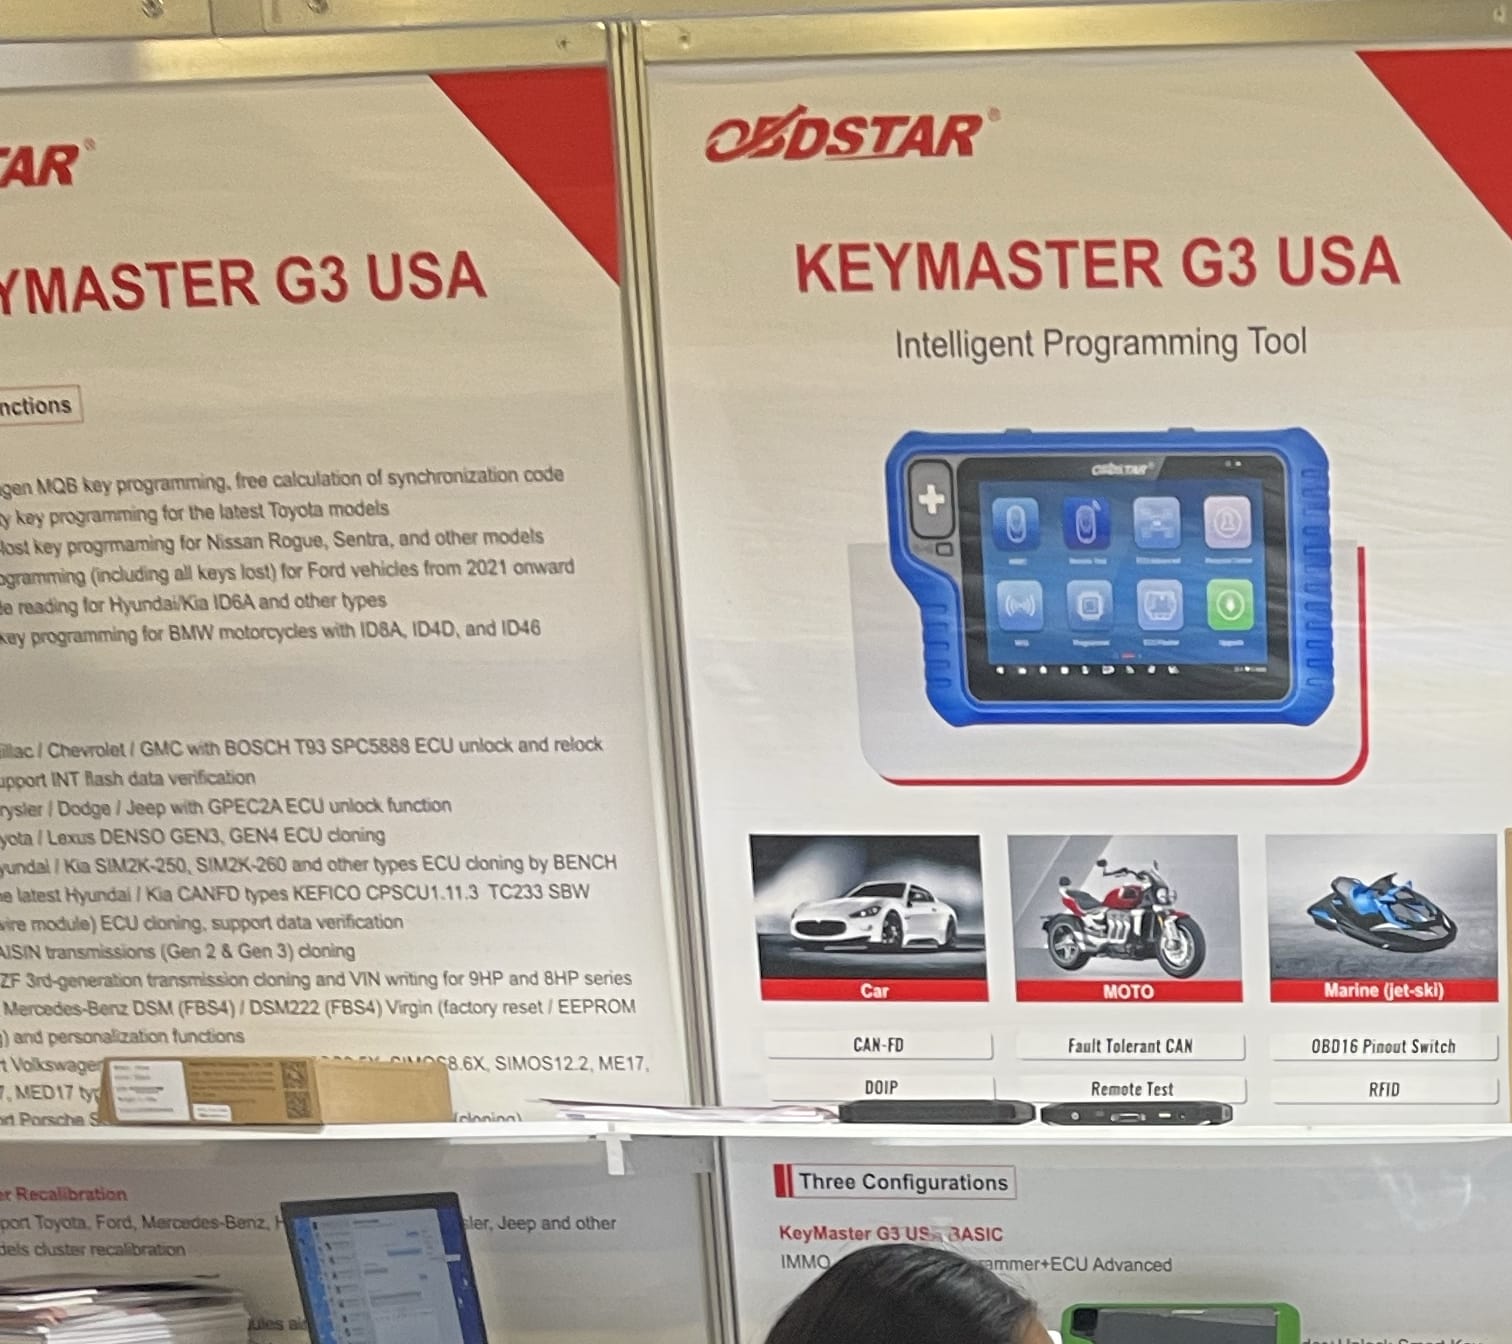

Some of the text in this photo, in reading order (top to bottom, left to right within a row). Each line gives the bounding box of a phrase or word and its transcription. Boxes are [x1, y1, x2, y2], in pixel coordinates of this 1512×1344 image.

[705, 104, 984, 163] OBDSTAR
[795, 234, 1401, 295] KEYMASTER G3 USA
[275, 259, 350, 306] G3
[367, 254, 487, 304] USA
[895, 326, 1307, 365] Intelligent Programming Tool
[35, 475, 79, 495] MQB
[81, 474, 113, 498] key
[115, 471, 232, 497] programming,
[234, 470, 268, 491] free
[272, 468, 363, 490] calculation
[365, 468, 383, 488] of
[387, 465, 520, 491] synchronization
[523, 463, 565, 484] code
[855, 982, 894, 999] Car
[1097, 982, 1160, 1000] MOTO
[1318, 981, 1450, 1003] Marine (jet-ski)
[848, 1035, 909, 1054] CAN-FD
[1066, 1035, 1198, 1056] Fault Tolerant CAN
[1310, 1037, 1457, 1056] OBD16 Pinout Switch
[494, 1053, 650, 1075] SIMOS12.2, ME17,
[860, 1077, 902, 1095] DOIP
[1087, 1079, 1178, 1097] Remote Test
[1368, 1081, 1401, 1098] RFID
[15, 1183, 128, 1201] Recalibration
[798, 1171, 1009, 1195] Three Configurations
[777, 1223, 872, 1244] KeyMaster
[874, 1223, 901, 1241] G3
